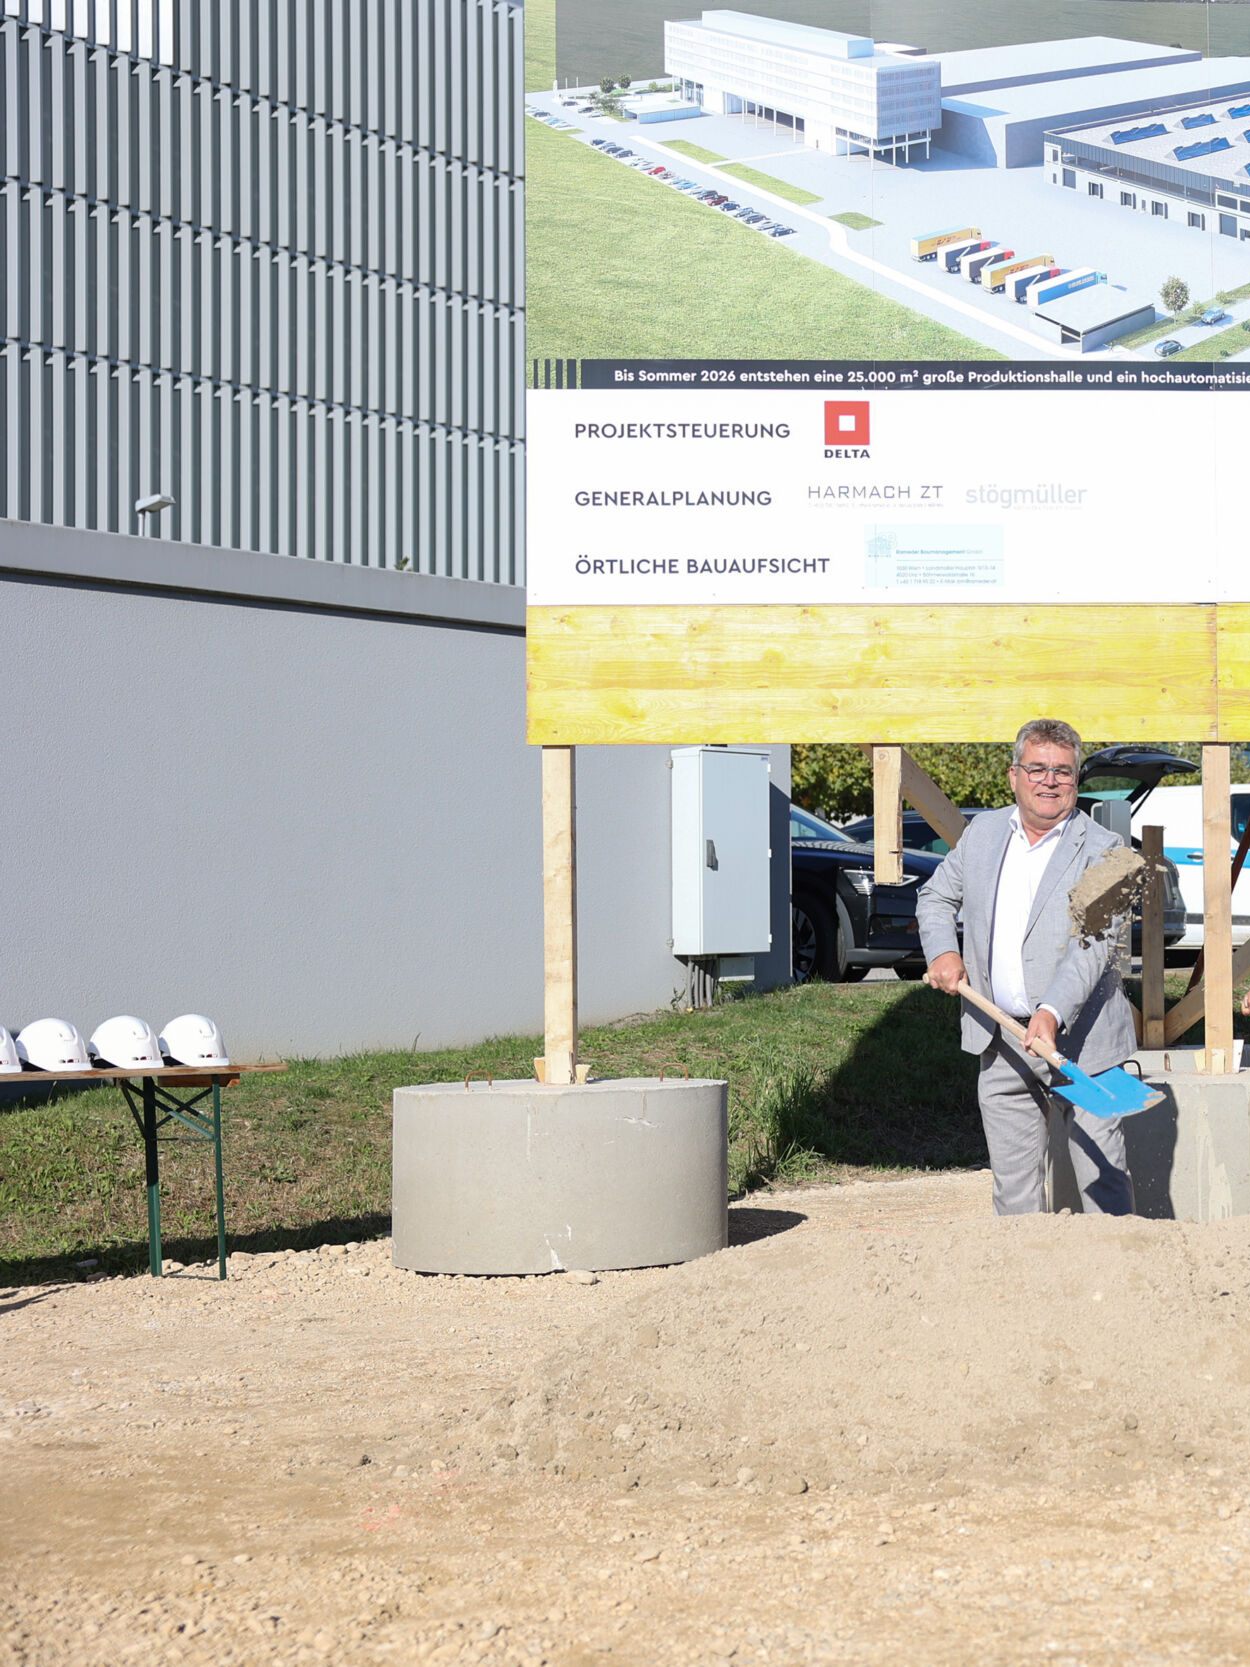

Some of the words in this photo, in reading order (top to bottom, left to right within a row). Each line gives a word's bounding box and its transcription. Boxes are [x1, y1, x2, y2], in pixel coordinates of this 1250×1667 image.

[615, 369, 634, 381] Bis
[639, 370, 696, 381] Sommer
[701, 370, 736, 381] 2026
[740, 370, 809, 382] entstehen
[814, 370, 843, 382] eine
[848, 371, 895, 382] 25.000
[923, 370, 964, 385] große
[969, 371, 1082, 382] Produktionshalle
[1087, 371, 1112, 382] und
[1117, 371, 1137, 383] ein
[576, 424, 790, 438] PROJEKTSTEUERUNG
[825, 449, 870, 458] DELTA
[575, 491, 771, 506] GENERALPLANUNG
[809, 486, 910, 498] HARMACH
[920, 486, 943, 498] ZT
[966, 484, 1088, 508] stögmüller
[576, 555, 679, 574] ÖRTLICHE
[687, 558, 830, 573] BAUAUFSICHT
